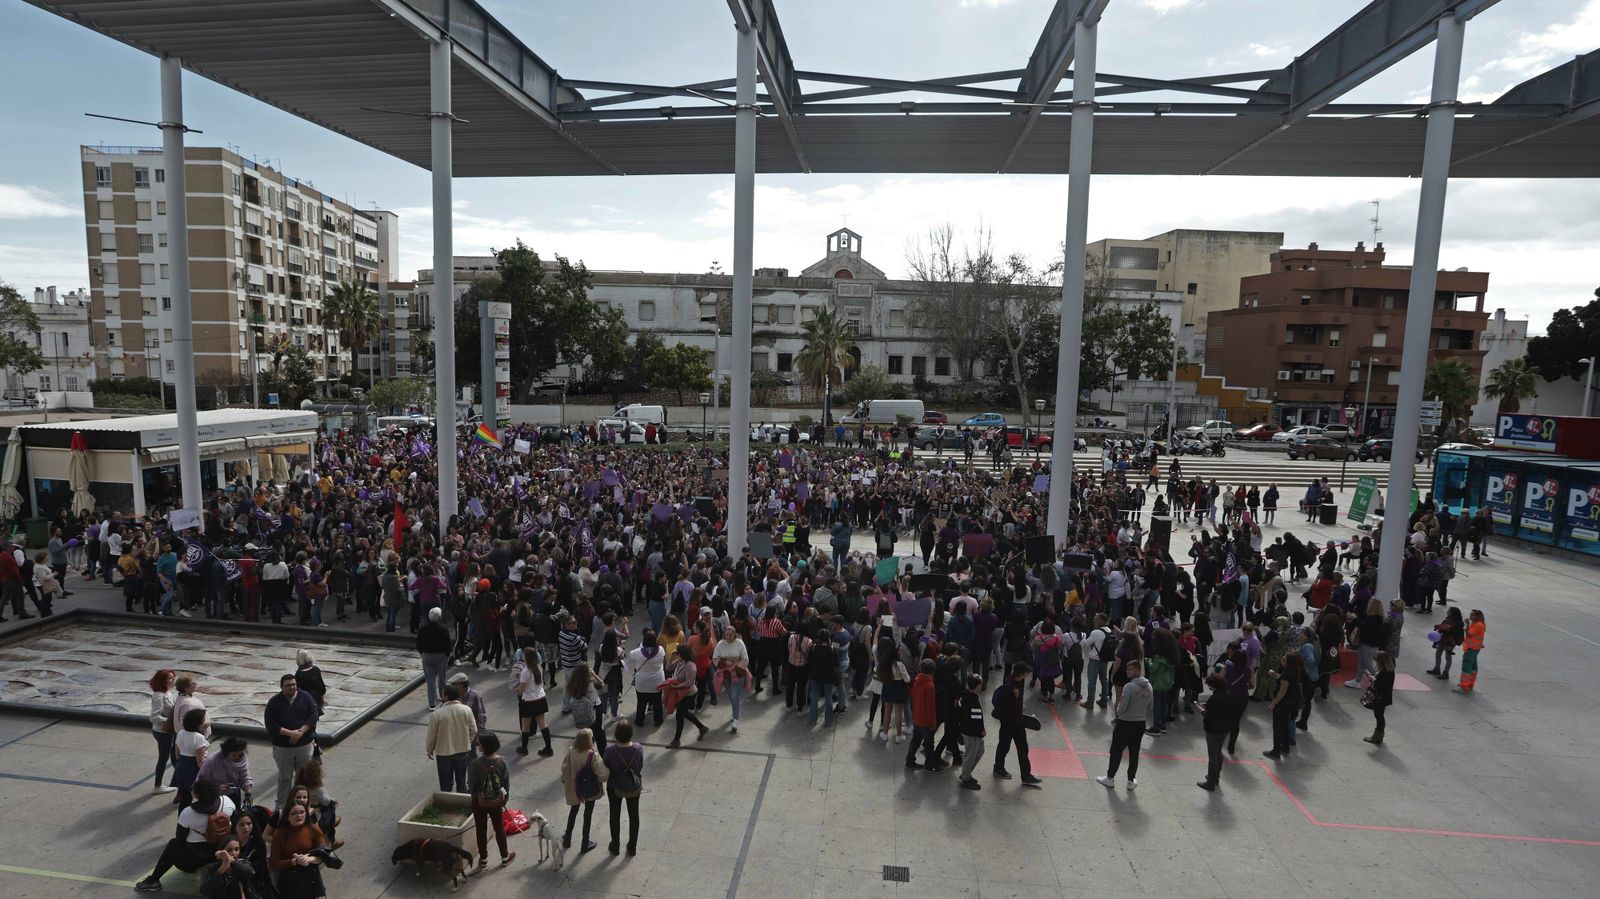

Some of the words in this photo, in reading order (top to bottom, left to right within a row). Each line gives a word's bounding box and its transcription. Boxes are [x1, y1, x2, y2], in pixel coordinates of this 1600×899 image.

[1499, 416, 1513, 437] P
[1486, 476, 1504, 501] P
[1524, 482, 1544, 509] P
[1567, 488, 1588, 517] P
